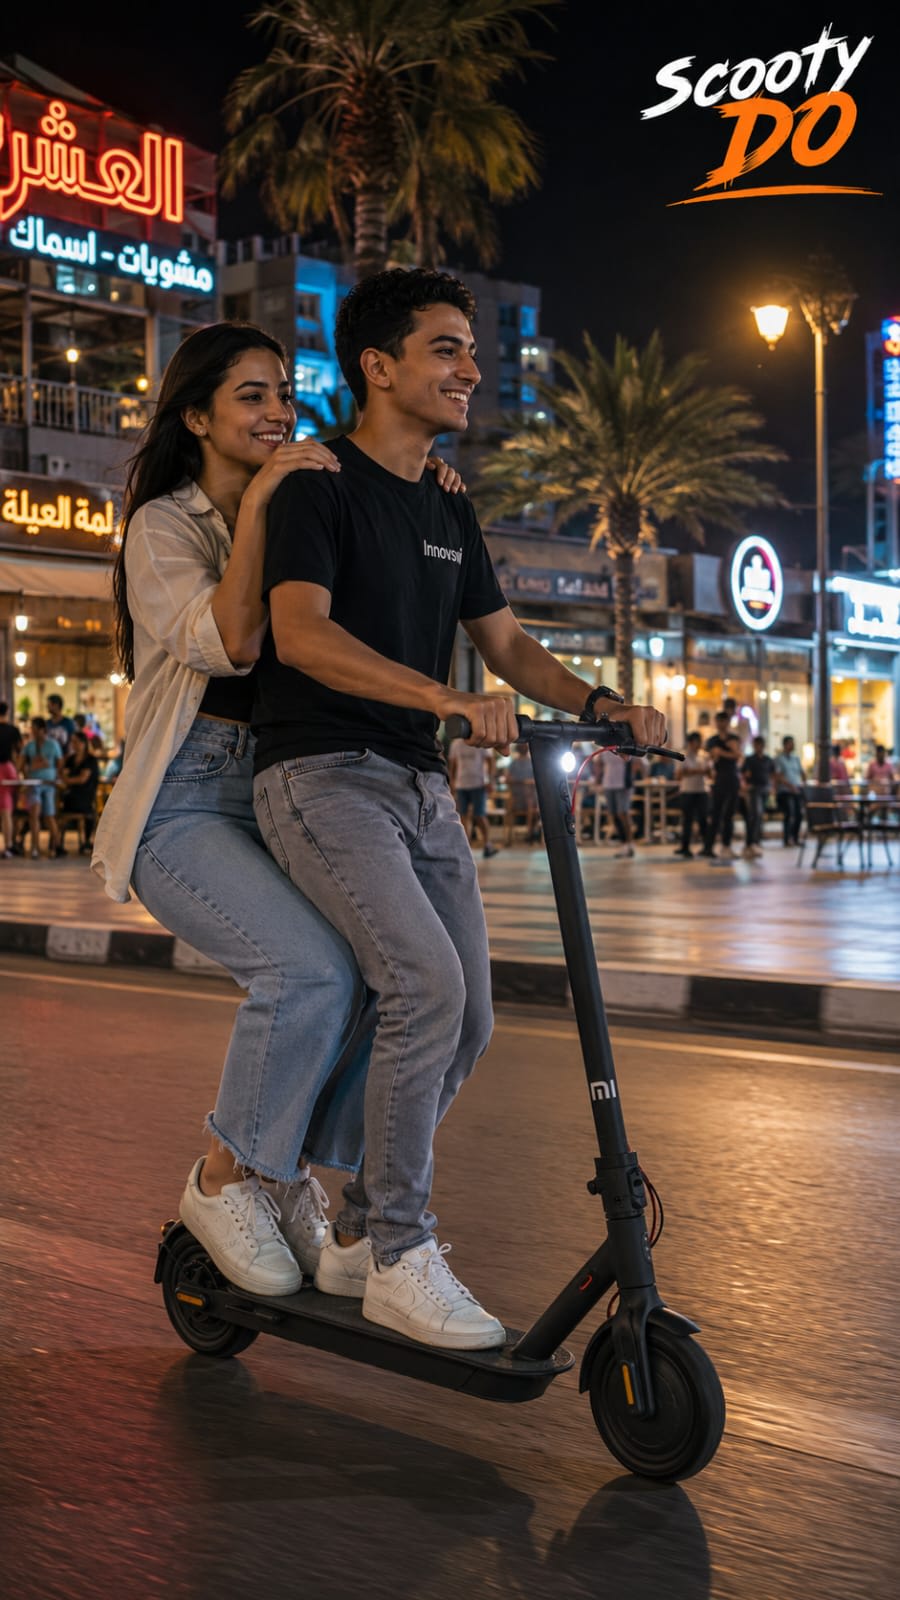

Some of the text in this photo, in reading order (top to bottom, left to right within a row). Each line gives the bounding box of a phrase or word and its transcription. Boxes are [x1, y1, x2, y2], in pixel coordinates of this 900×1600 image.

[0, 100, 184, 223] العشر
[117, 243, 213, 292] مشويات
[2, 488, 114, 536] لمة العيلة
